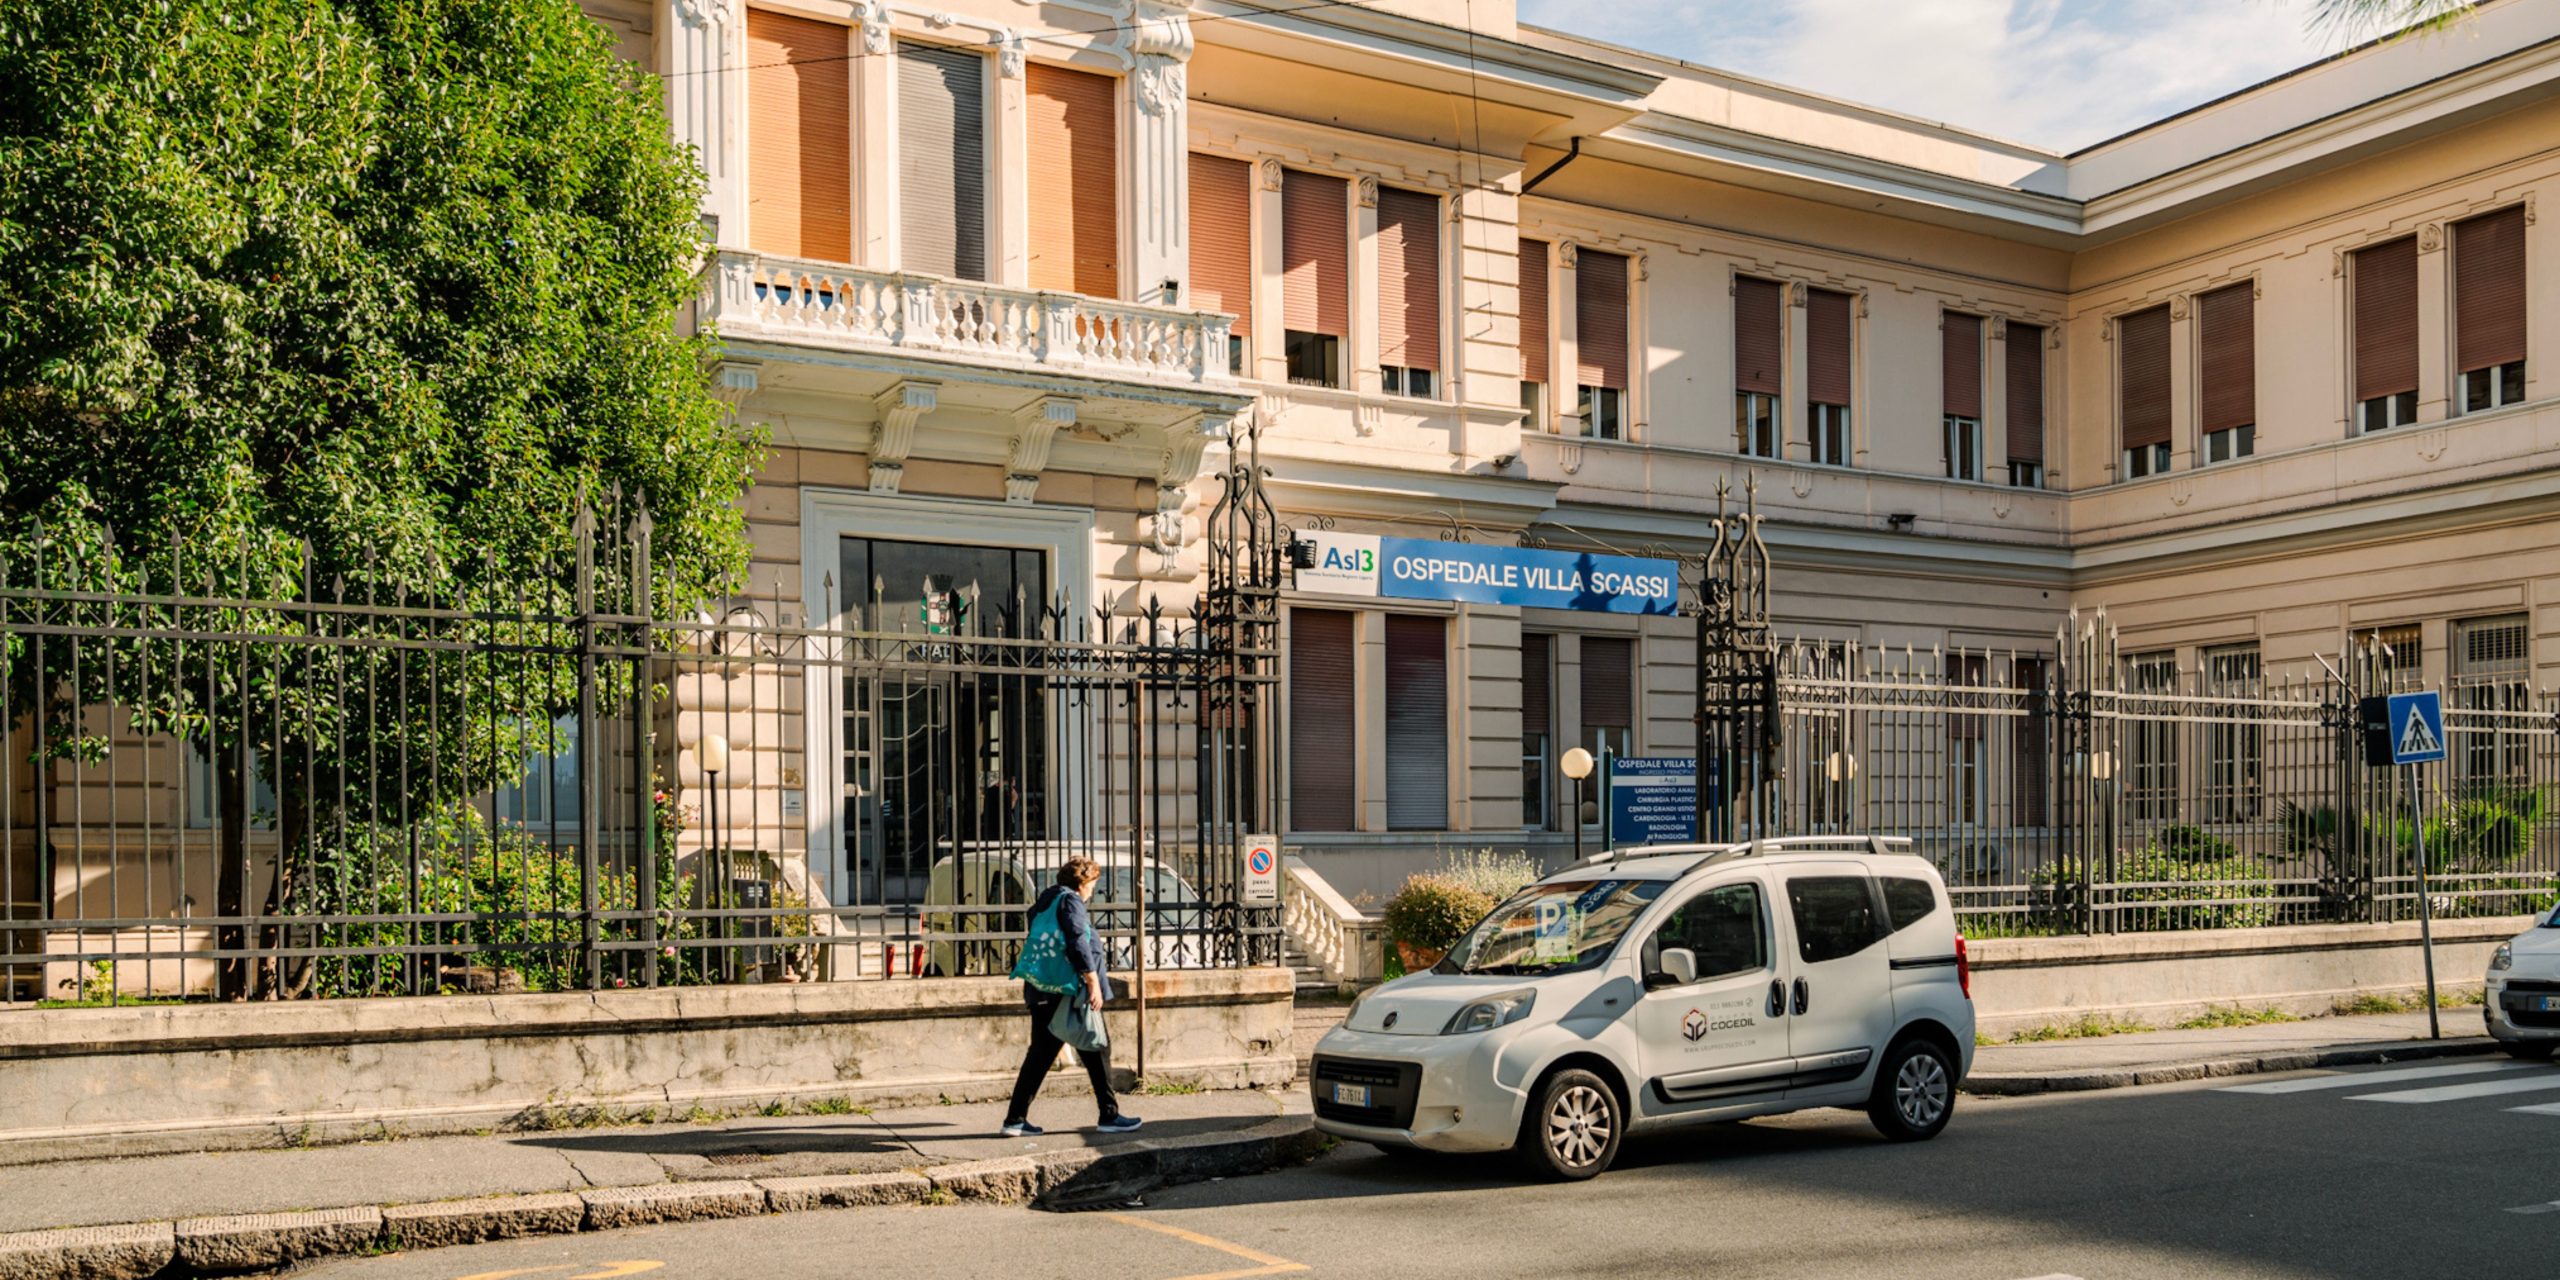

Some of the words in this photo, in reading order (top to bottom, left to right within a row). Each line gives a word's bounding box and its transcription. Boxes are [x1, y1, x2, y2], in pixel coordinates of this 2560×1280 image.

[1323, 547, 1374, 572] Asl3
[1393, 556, 1518, 588] OSPEDALE
[1523, 567, 1585, 592] VILLA
[1590, 571, 1669, 599] SCASSI
[1618, 760, 1661, 769] OSPEDALE
[1663, 760, 1686, 768] VILLA
[1711, 1018, 1755, 1031] COGEDIL
